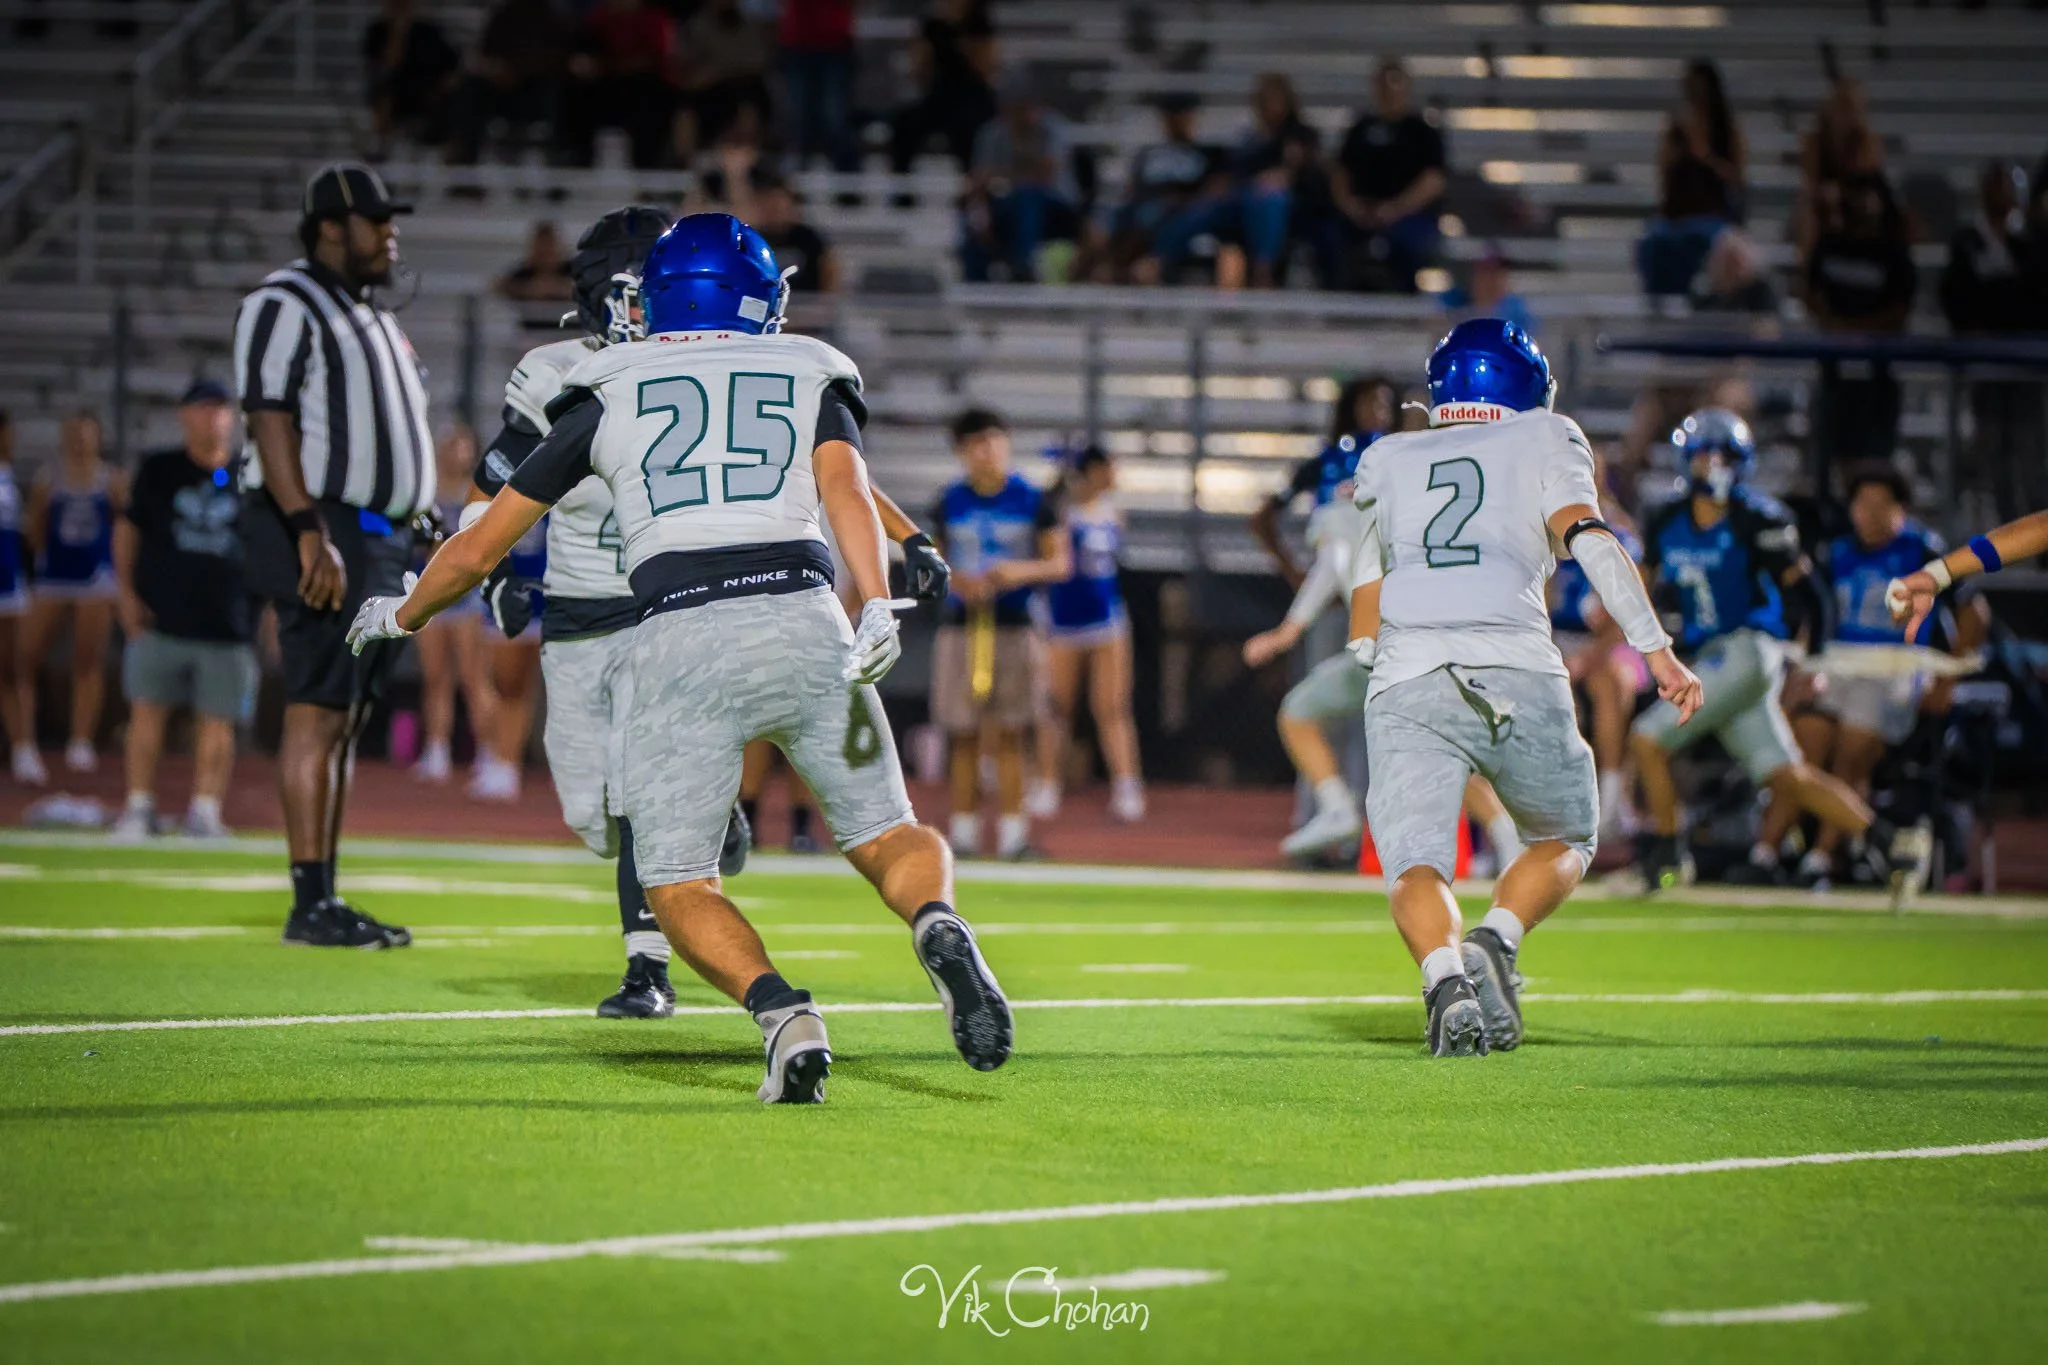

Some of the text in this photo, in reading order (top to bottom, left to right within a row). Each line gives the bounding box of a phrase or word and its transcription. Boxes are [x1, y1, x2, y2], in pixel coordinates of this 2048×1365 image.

[636, 372, 797, 517] 25
[1440, 406, 1501, 421] Riddell
[1423, 456, 1484, 568] 2
[741, 569, 789, 585] NIKE
[802, 568, 828, 585] NIK
